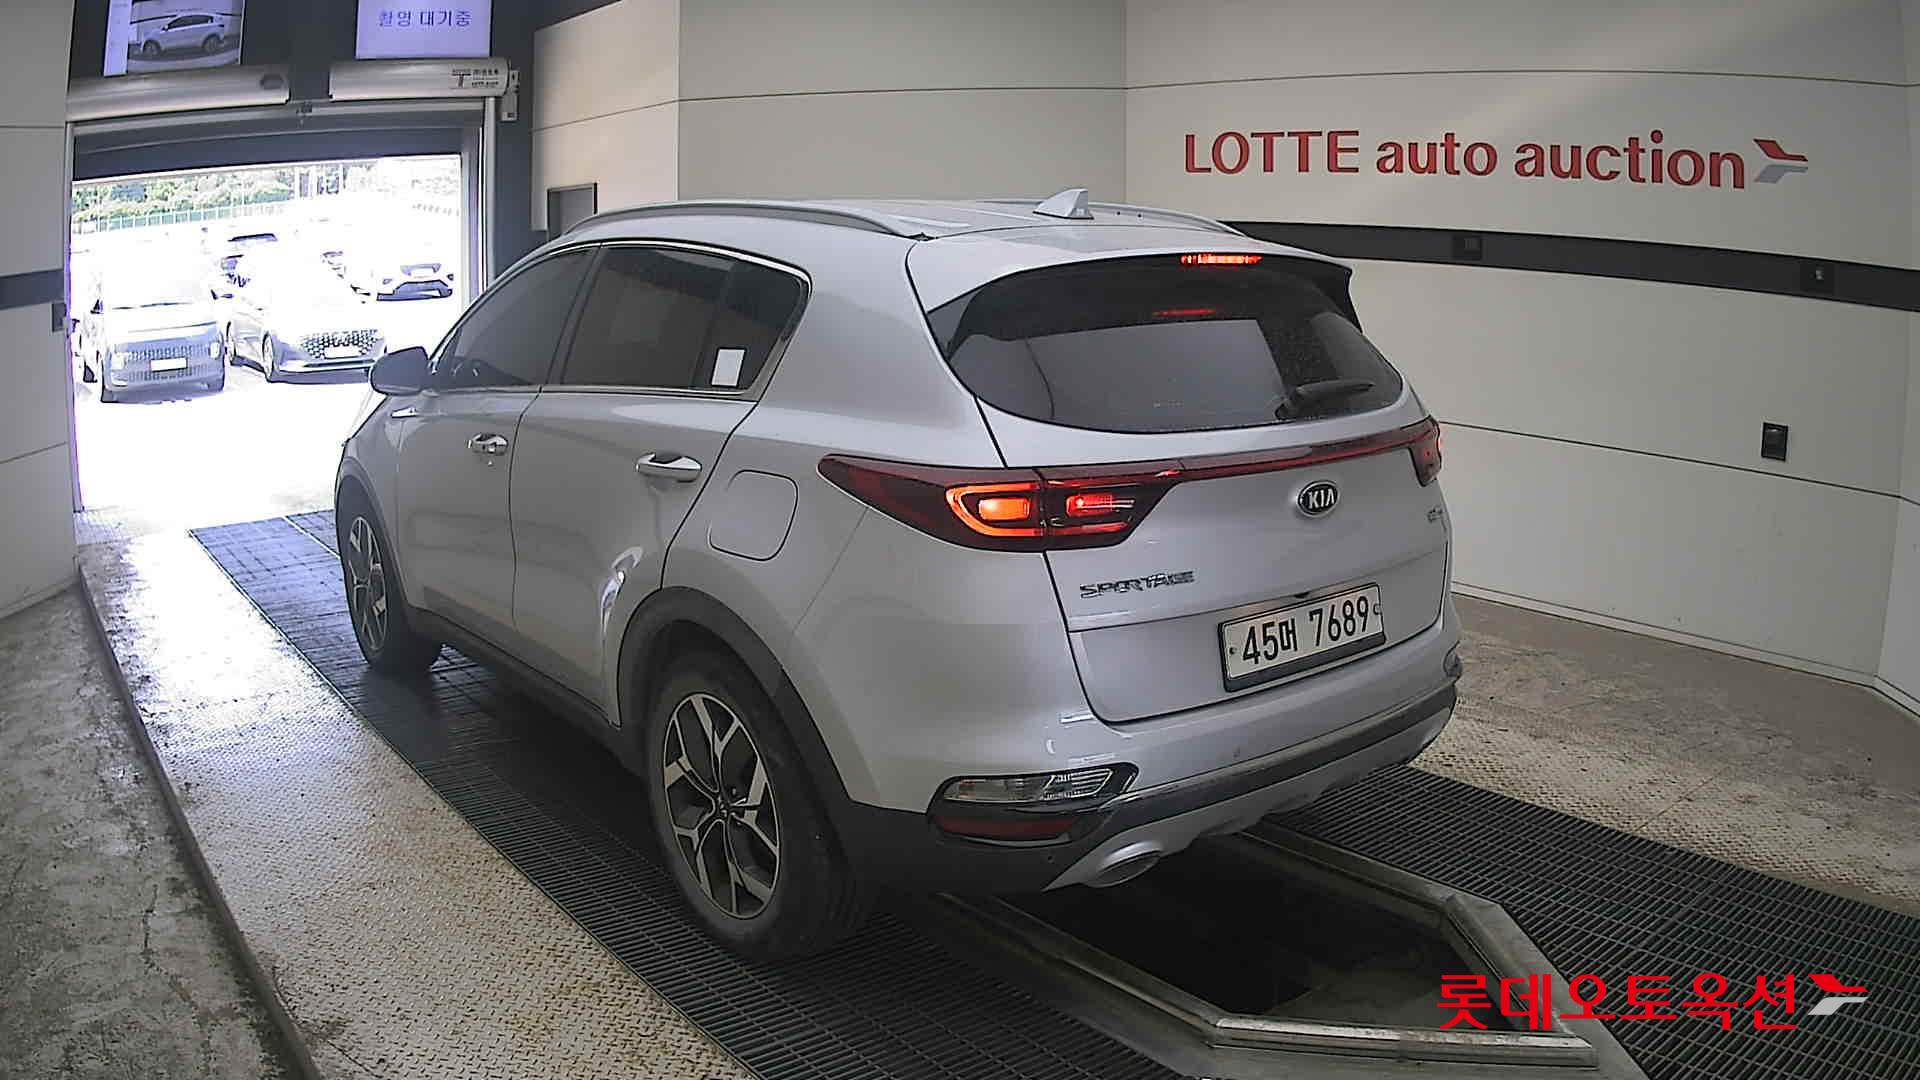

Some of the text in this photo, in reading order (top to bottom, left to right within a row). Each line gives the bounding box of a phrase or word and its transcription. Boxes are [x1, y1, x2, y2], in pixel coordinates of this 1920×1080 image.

[420, 10, 472, 27] 대기중
[1185, 130, 1745, 189] LOTTE auto auction
[1308, 488, 1335, 509] KIA
[1243, 595, 1369, 664] 45머 7689
